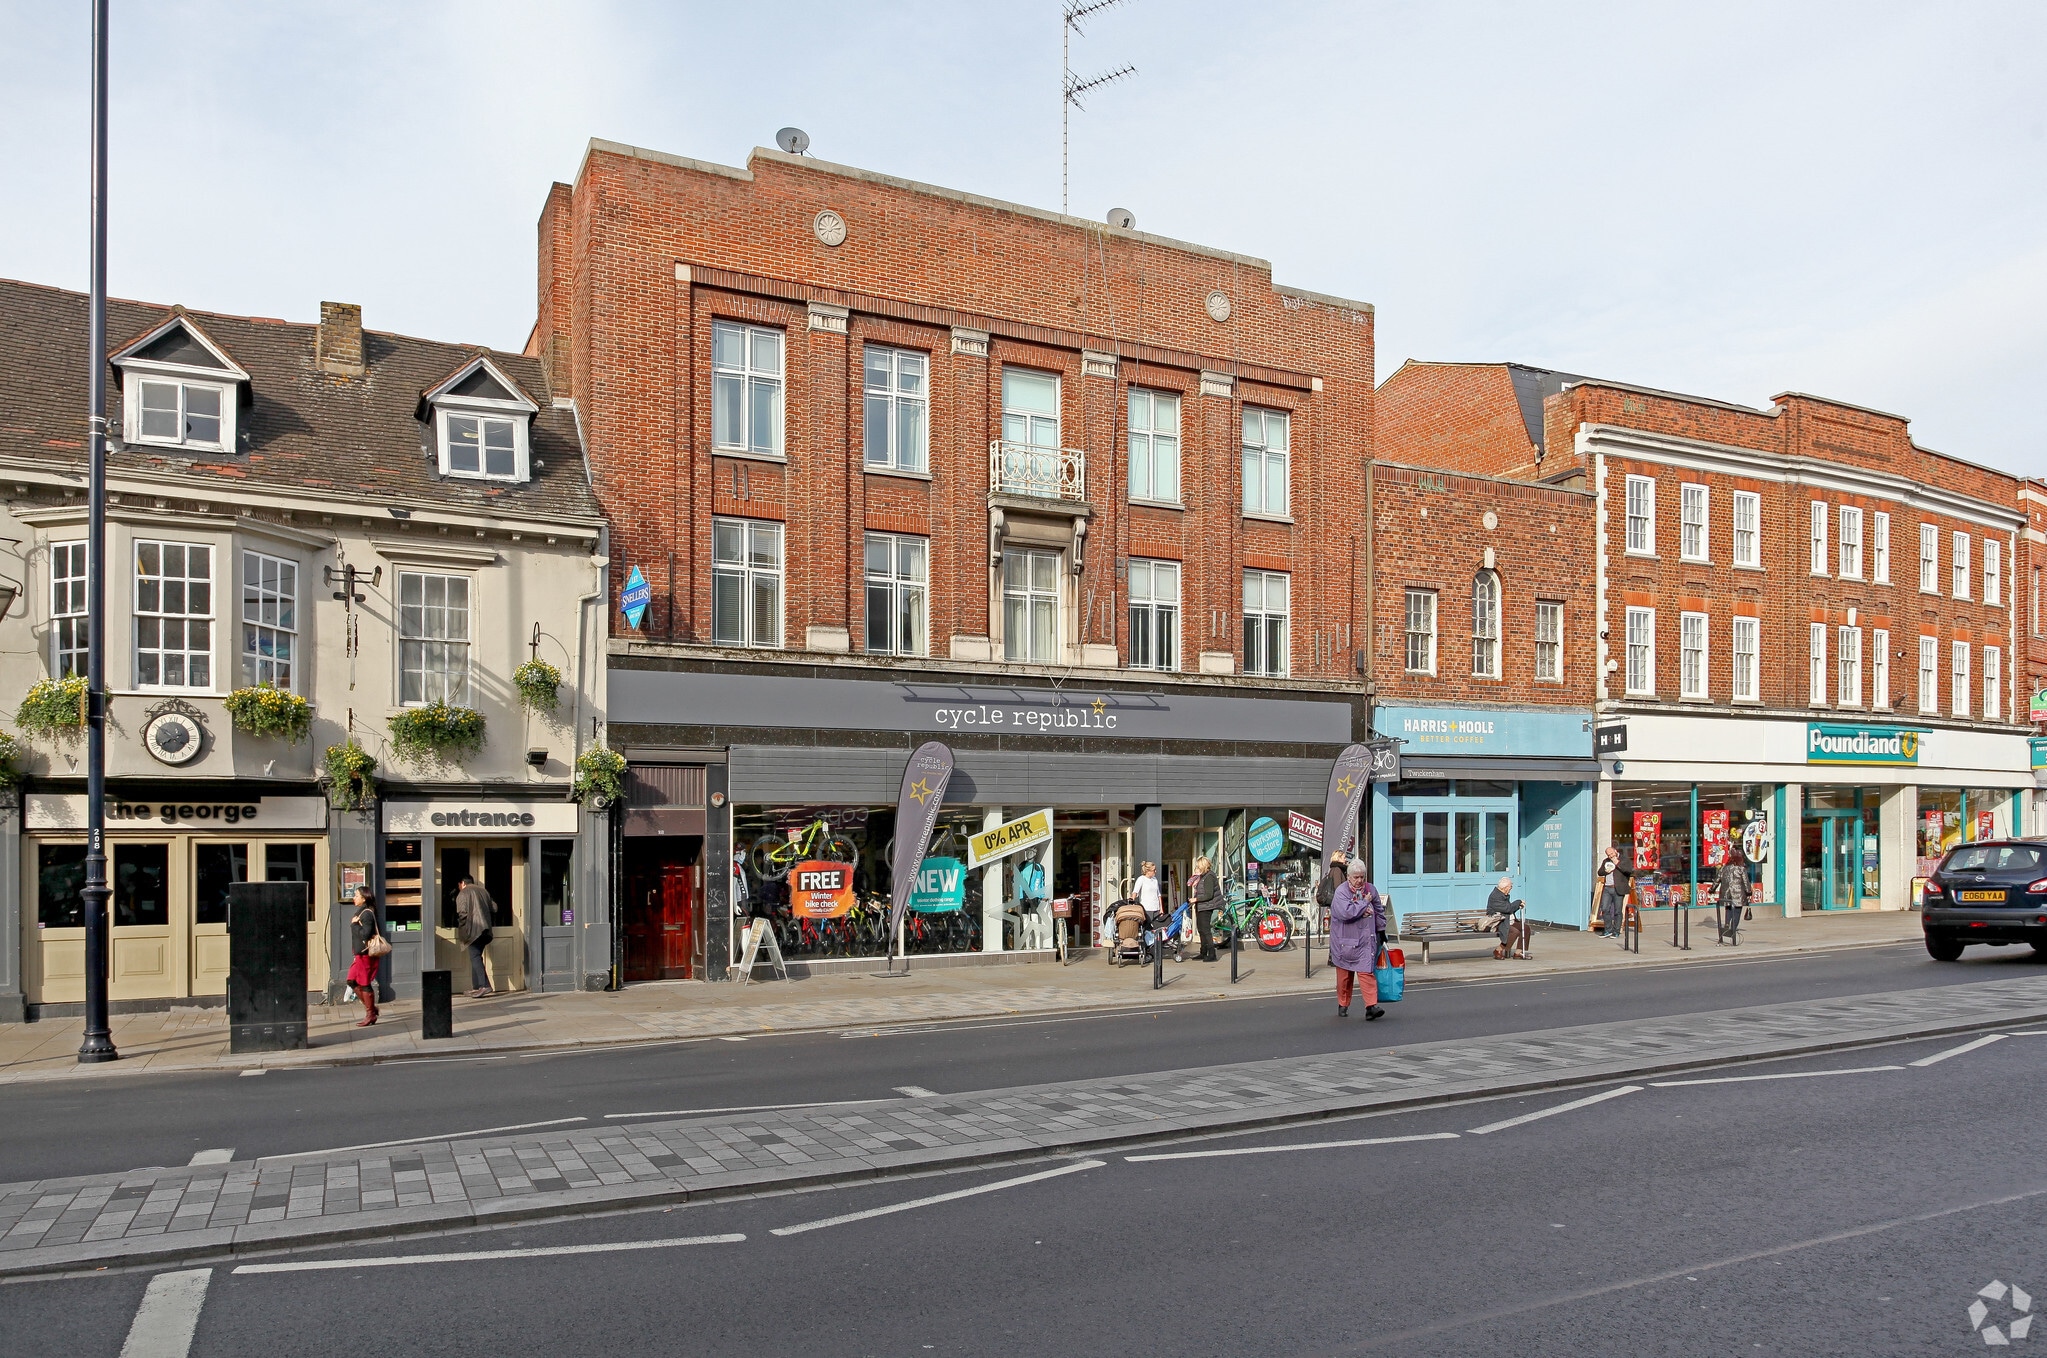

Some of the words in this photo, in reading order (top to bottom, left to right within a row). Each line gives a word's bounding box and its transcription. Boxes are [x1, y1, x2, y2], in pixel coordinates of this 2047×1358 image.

[622, 587, 649, 608] SNELLERS
[935, 705, 1003, 729] cycle
[1012, 708, 1117, 731] republic
[1404, 719, 1447, 733] HARRIS
[1458, 721, 1495, 734] HOOLE
[1420, 735, 1450, 743] BETTER
[1453, 735, 1485, 744] COFFEE
[1810, 729, 1902, 754] Poundland
[1408, 769, 1446, 778] Twickenham
[104, 802, 152, 820] the
[159, 803, 258, 825] george
[430, 808, 536, 827] entrance
[908, 787, 942, 882] www.cyclerepublic.com
[984, 830, 1006, 850] 0%
[1008, 820, 1033, 842] APR
[1291, 816, 1306, 832] TAX
[1305, 822, 1323, 838] FREE
[93, 828, 101, 850] 208
[1250, 828, 1280, 849] workshop
[1255, 839, 1280, 857] in-store
[800, 871, 841, 891] FREE
[913, 868, 959, 894] NEW
[805, 900, 819, 908] bike
[820, 900, 839, 908] check
[810, 892, 833, 900] Winter
[1987, 891, 2003, 899] YAA
[1262, 919, 1281, 930] SALE
